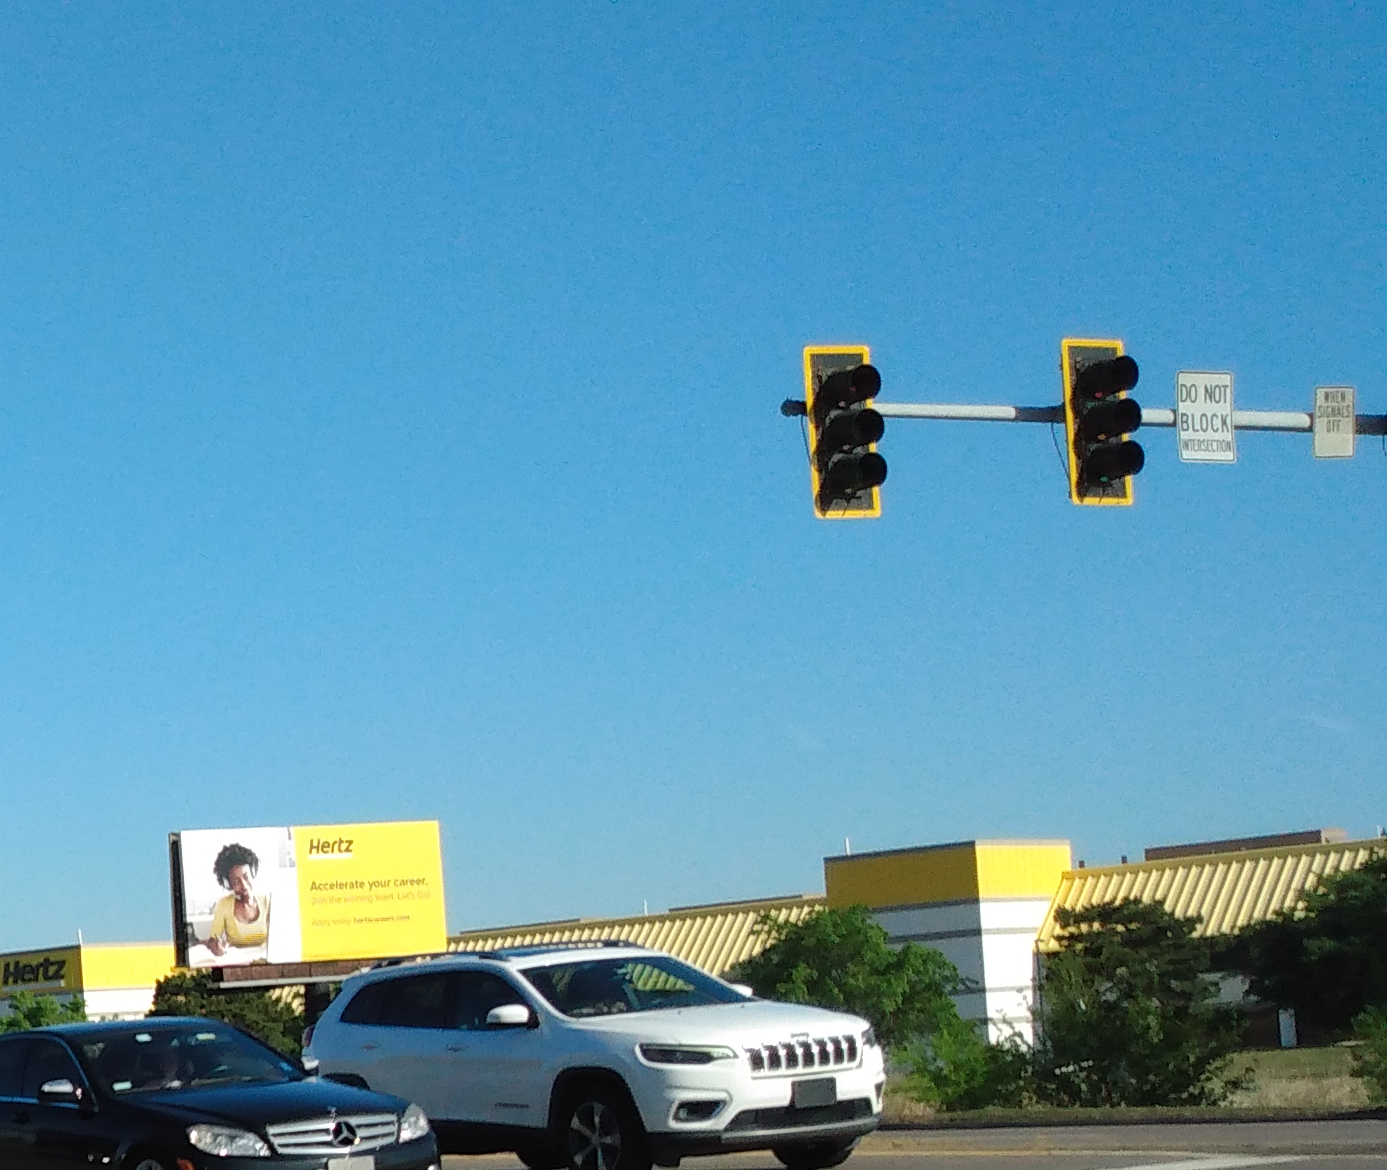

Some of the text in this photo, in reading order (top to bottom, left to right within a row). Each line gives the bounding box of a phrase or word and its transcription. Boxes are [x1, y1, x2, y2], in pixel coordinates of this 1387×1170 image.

[1180, 383, 1229, 404] DO NOT
[1180, 412, 1230, 433] BLOCK
[1182, 438, 1232, 452] INTERSECTION
[308, 837, 354, 855] Hertz
[309, 877, 428, 892] Accelerate your career.
[3, 957, 66, 986] Hertz
